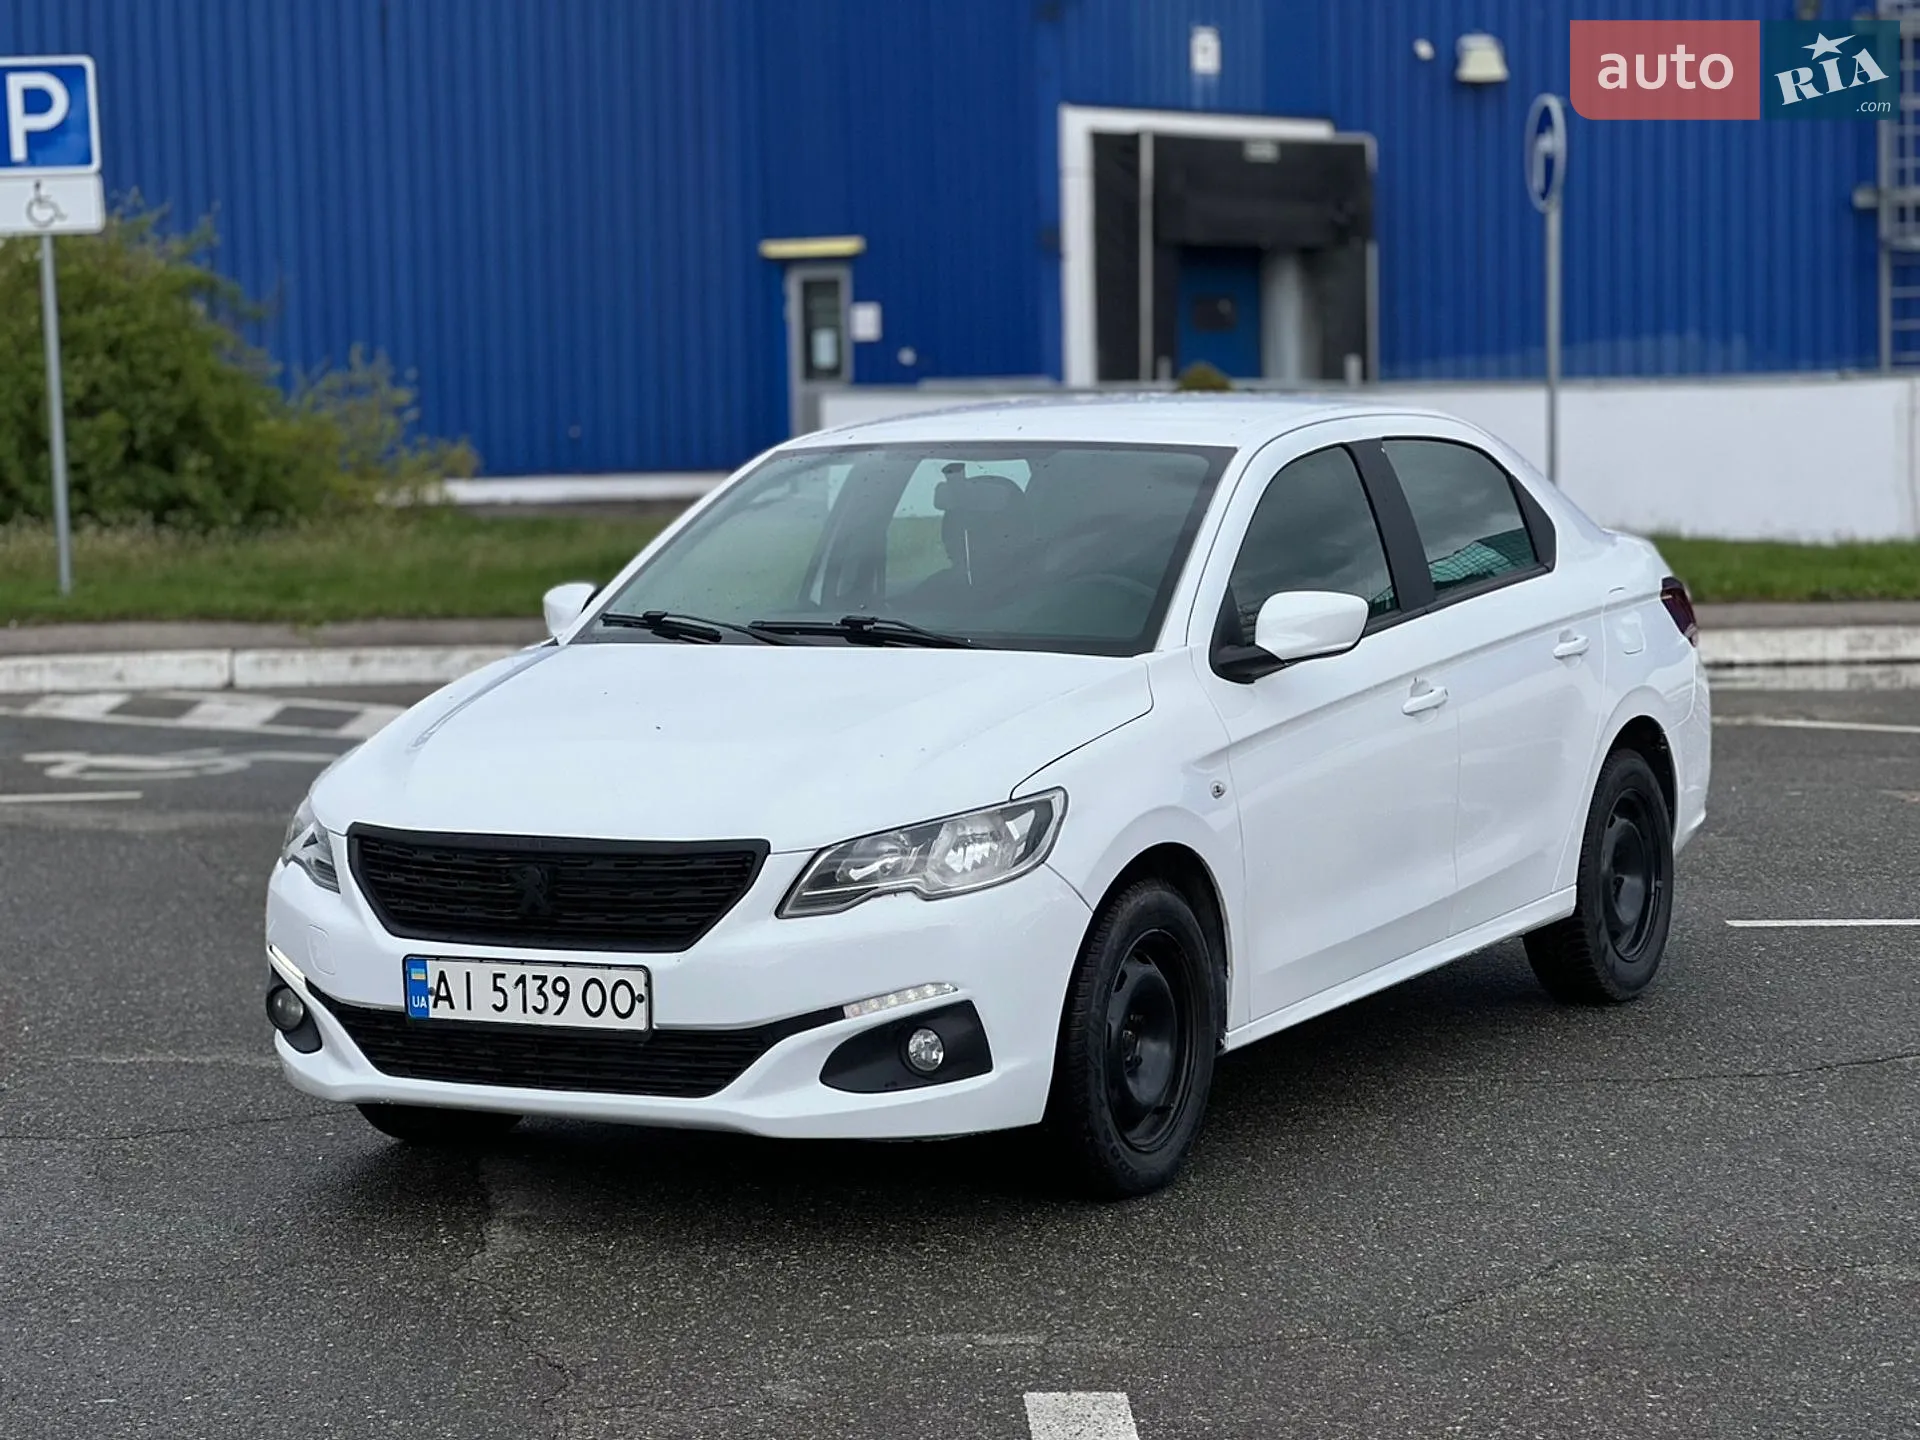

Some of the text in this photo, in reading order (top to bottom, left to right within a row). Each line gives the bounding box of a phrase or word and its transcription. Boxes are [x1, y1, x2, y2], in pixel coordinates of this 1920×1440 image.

[5, 71, 70, 162] P
[412, 995, 427, 1008] UA
[432, 970, 472, 1011] AI
[491, 972, 571, 1016] 5139
